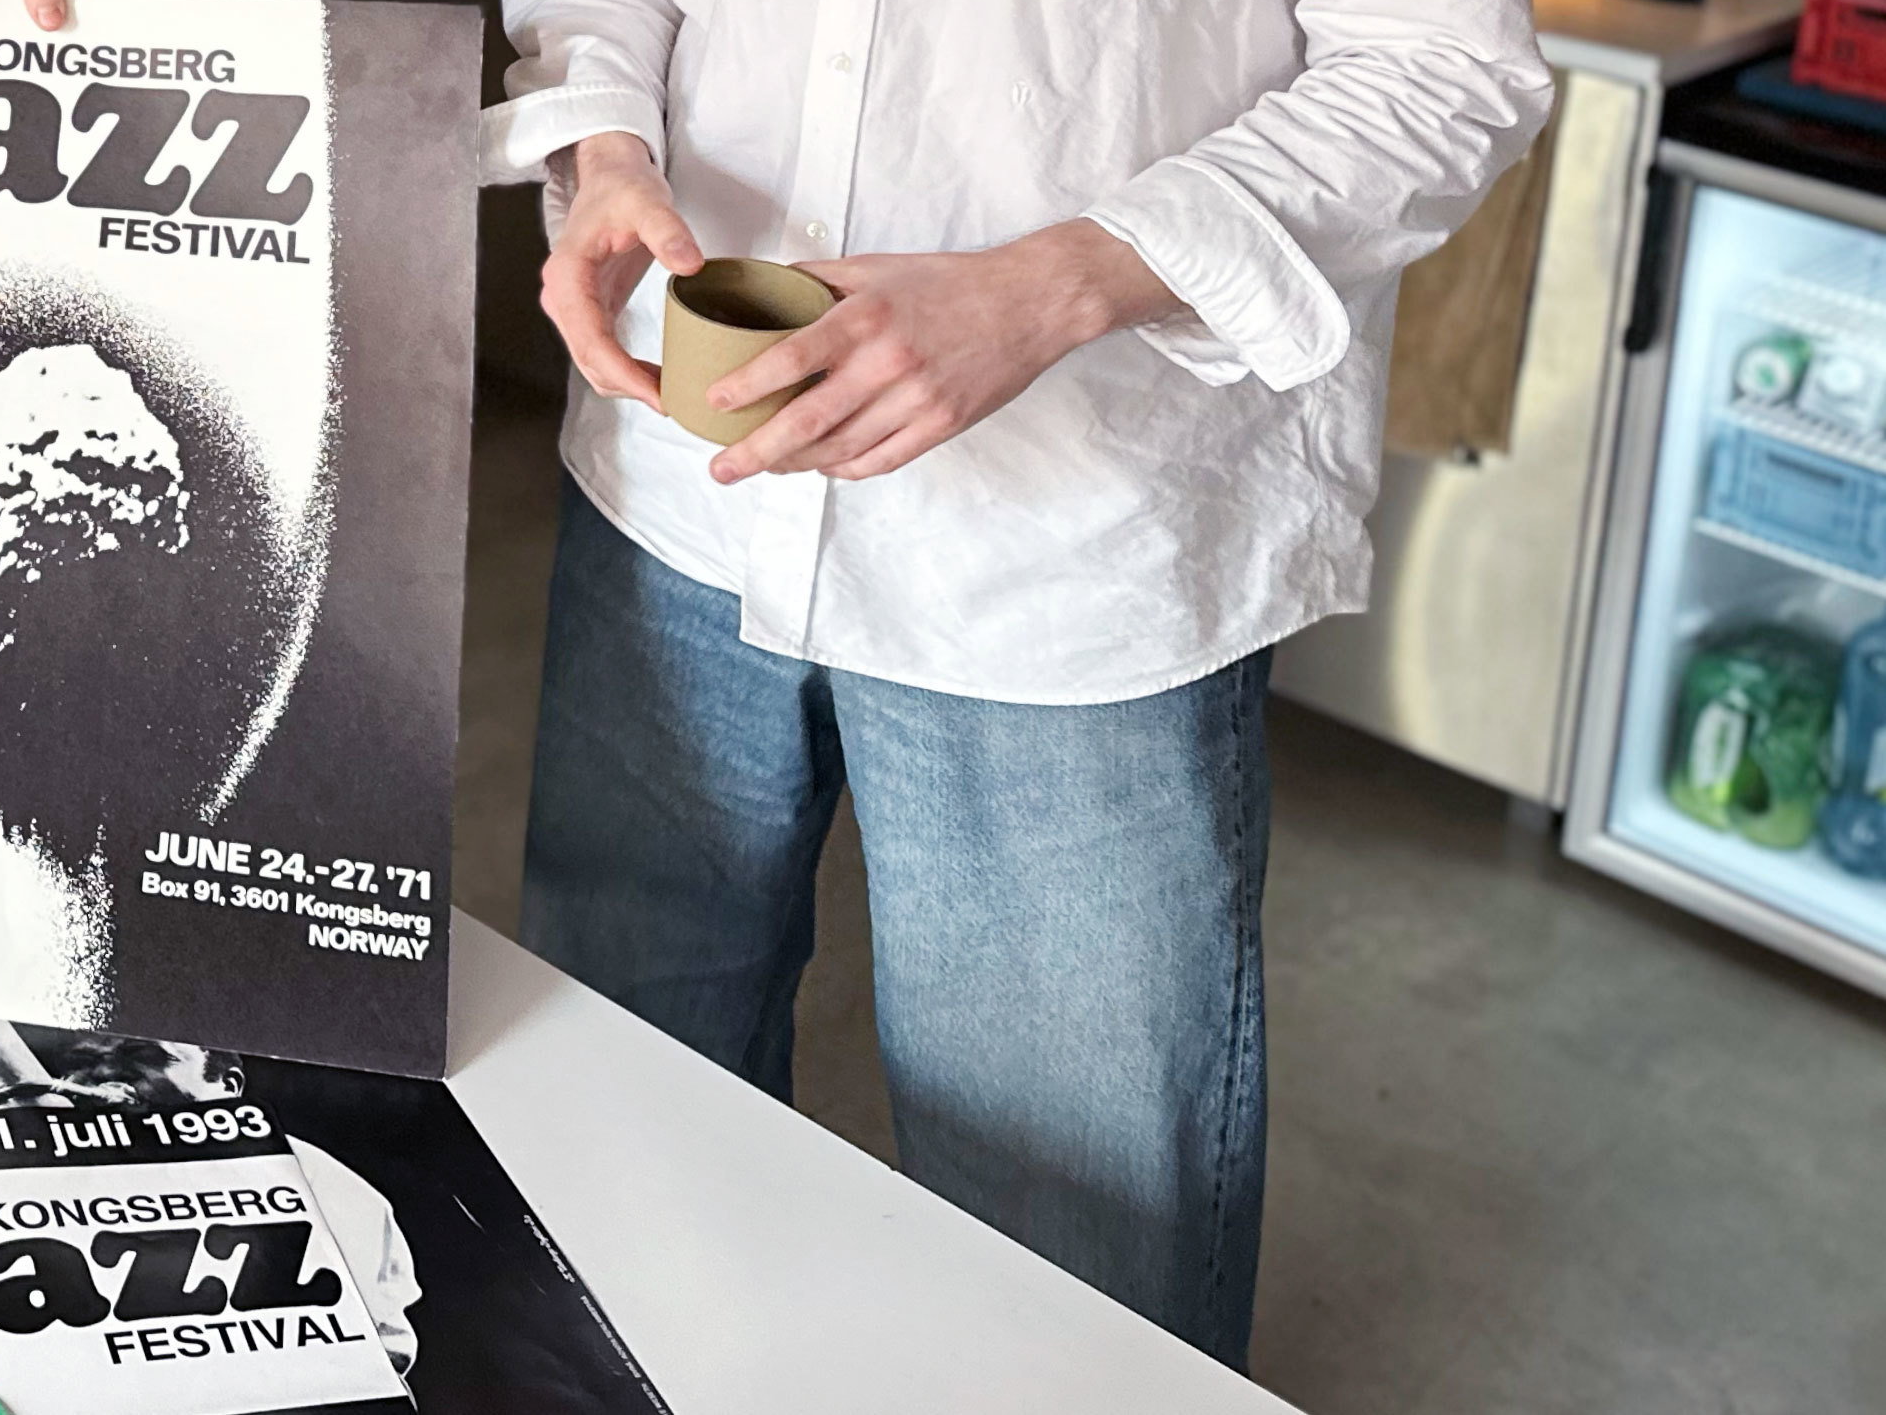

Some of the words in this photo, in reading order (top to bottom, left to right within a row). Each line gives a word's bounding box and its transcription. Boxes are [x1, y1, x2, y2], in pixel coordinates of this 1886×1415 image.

[98, 217, 311, 265] FESTIVAL
[145, 831, 252, 875] JUNE
[386, 866, 432, 900] '71
[142, 871, 189, 898] Box
[193, 879, 226, 907] 91,
[230, 885, 289, 913] 3601
[295, 893, 431, 937] Kongsberg
[308, 924, 430, 961] NORWAY
[47, 1112, 131, 1157] juli
[142, 1105, 272, 1147] 1993
[104, 1312, 366, 1365] FESTIVAL
